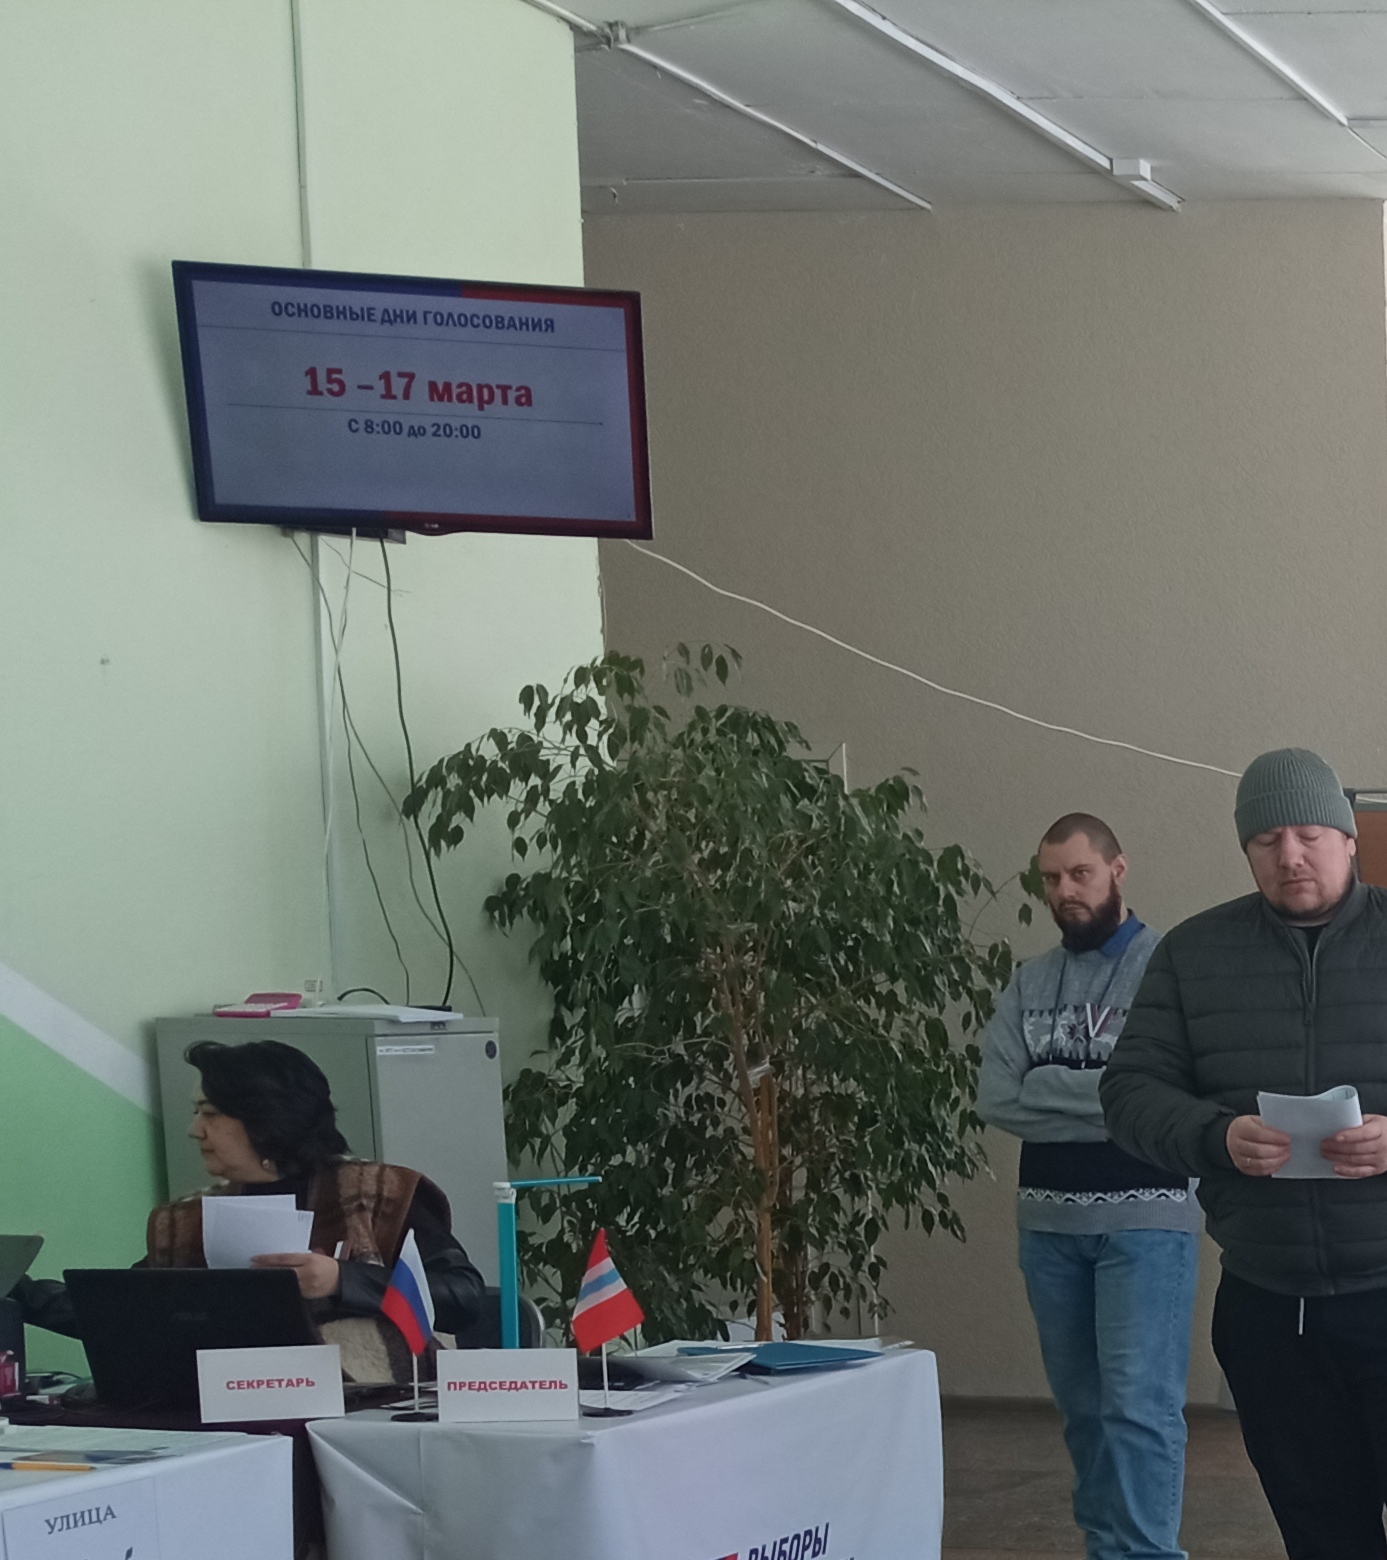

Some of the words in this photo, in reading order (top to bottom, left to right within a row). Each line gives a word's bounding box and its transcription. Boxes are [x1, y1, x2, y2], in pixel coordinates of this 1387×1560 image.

[270, 300, 376, 324] ОСНОВНЫЕ
[380, 307, 418, 327] ДНИ
[422, 310, 555, 334] ГОЛОСОВАНИЯ
[304, 366, 346, 397] 15
[427, 378, 534, 411] марта
[347, 418, 360, 434] С
[364, 419, 404, 437] 8:00
[407, 424, 427, 439] до
[431, 422, 482, 440] 20:00
[225, 1377, 316, 1391] СЕКРЕТАРЬ
[446, 1380, 569, 1393] ПРЕДСЕДАТЕЛЬ
[44, 1504, 117, 1536] УЛИЦА
